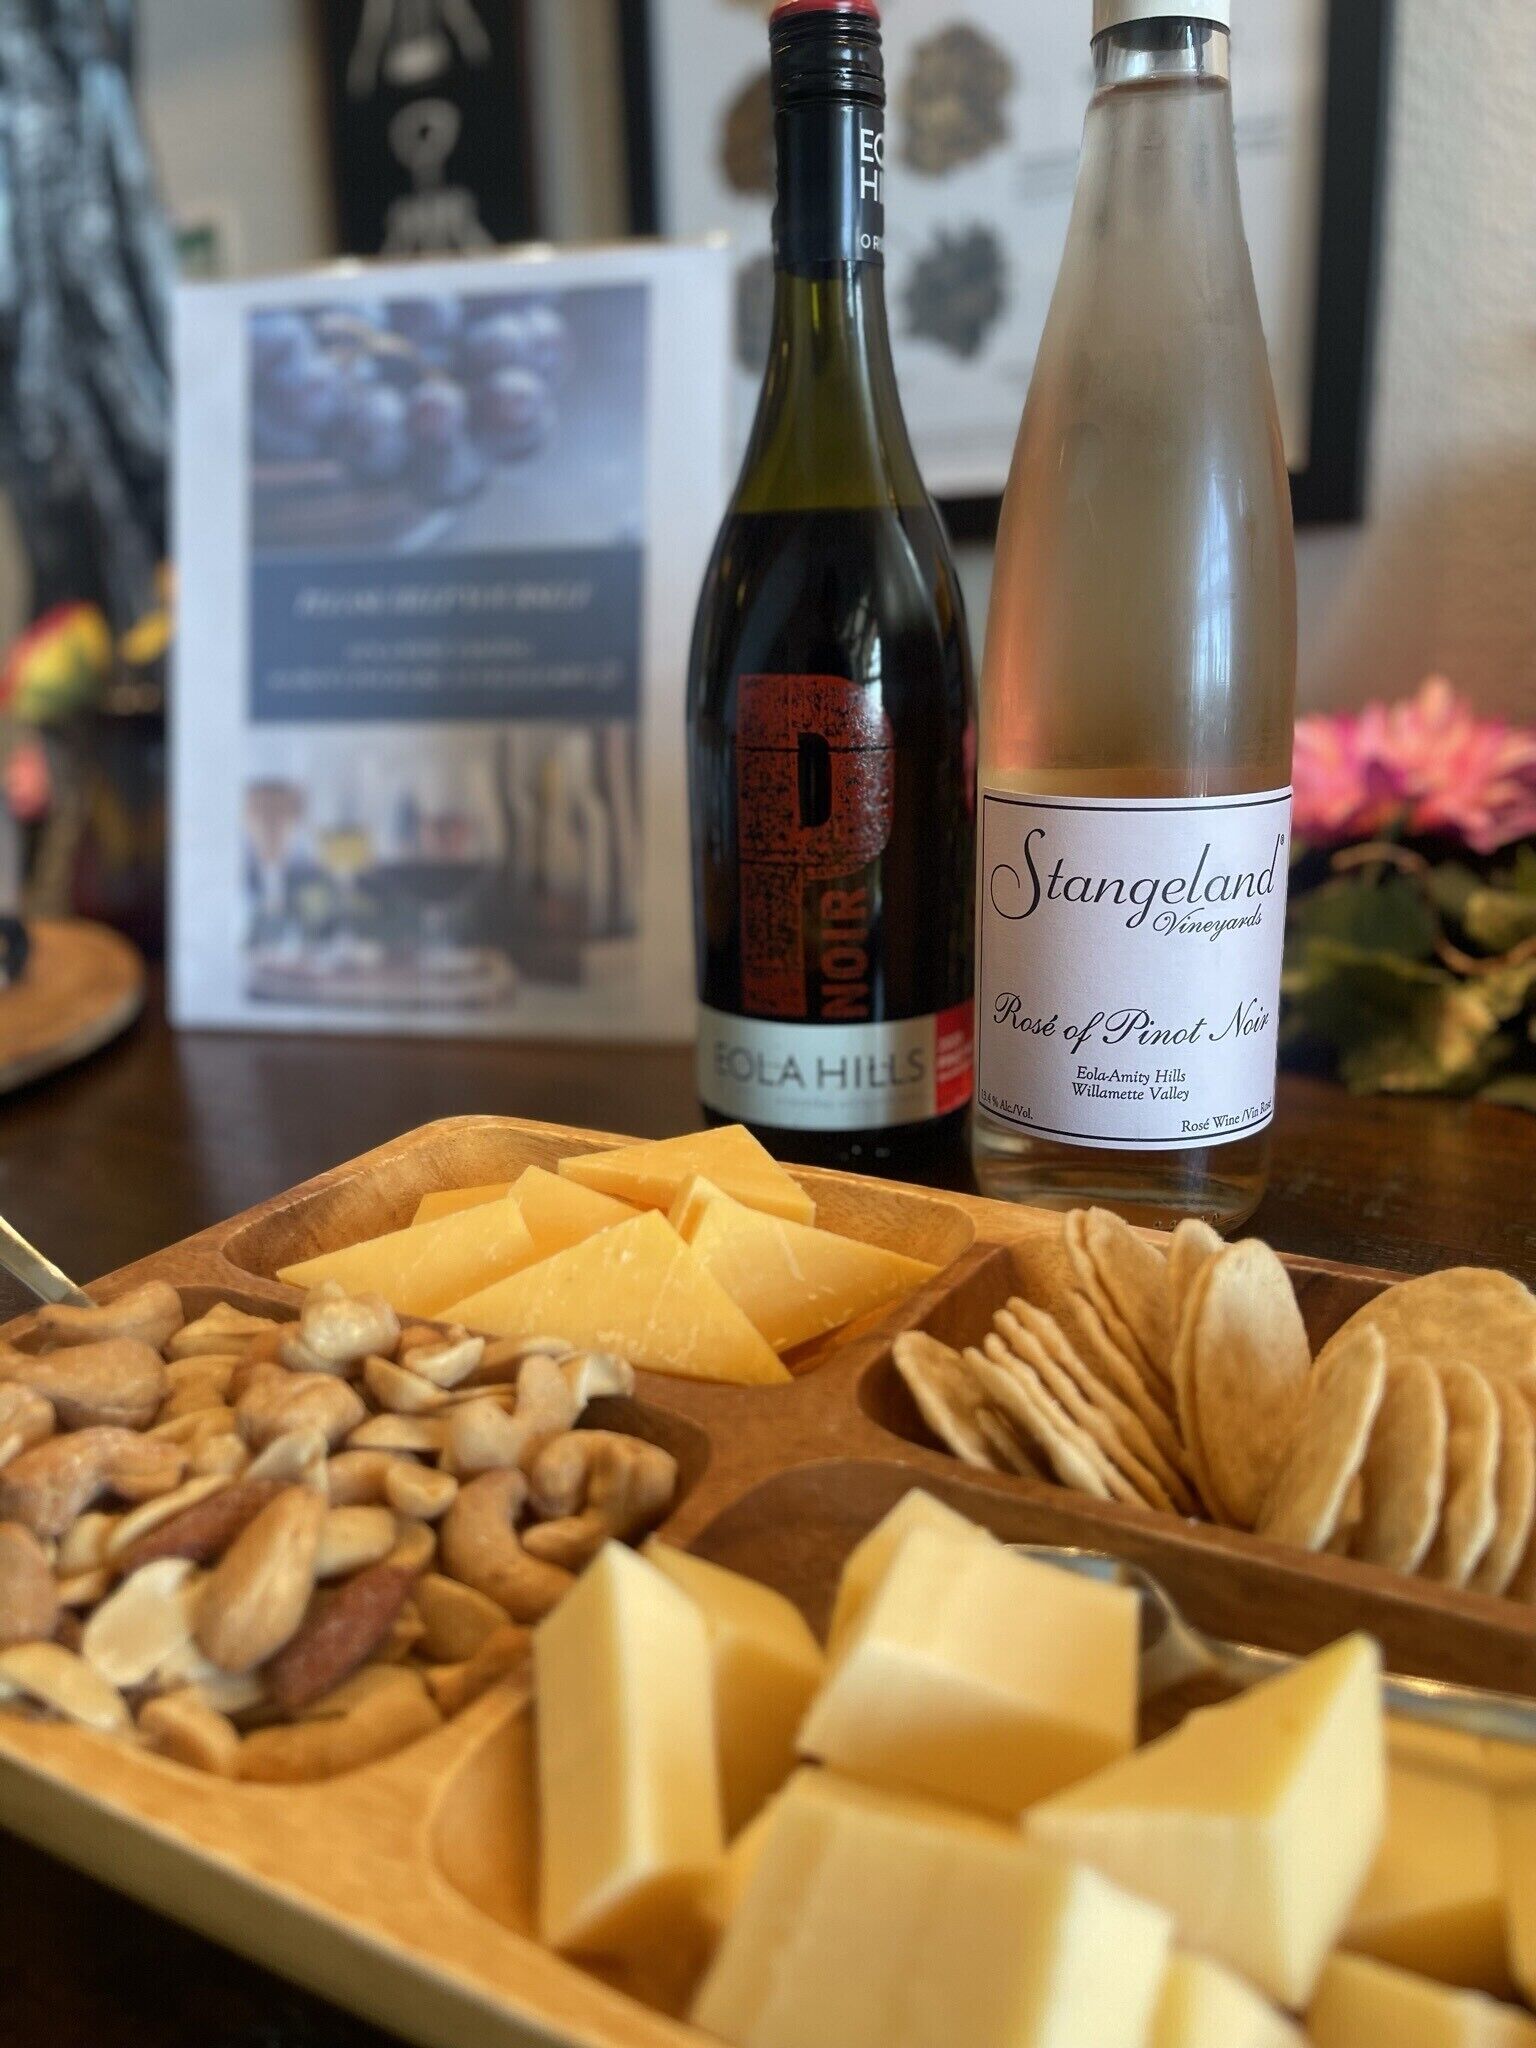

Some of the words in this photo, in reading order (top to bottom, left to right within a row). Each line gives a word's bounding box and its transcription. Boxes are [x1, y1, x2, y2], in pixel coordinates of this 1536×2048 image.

[1152, 904, 1263, 942] Vineyards
[821, 888, 869, 1018] NOIR
[993, 992, 1057, 1037] Rosé
[1063, 1011, 1103, 1054] of
[1103, 1008, 1208, 1046] Pinot
[1208, 997, 1270, 1042] Noir
[714, 1040, 806, 1091] EOLA
[816, 1048, 926, 1090] HILLS
[1076, 1065, 1150, 1085] Eola-Amity
[1154, 1068, 1186, 1083] Hills
[1071, 1082, 1145, 1100] Willamette
[1149, 1086, 1190, 1102] Valley
[1181, 1118, 1210, 1133] Rosé
[1213, 1114, 1240, 1129] Wine
